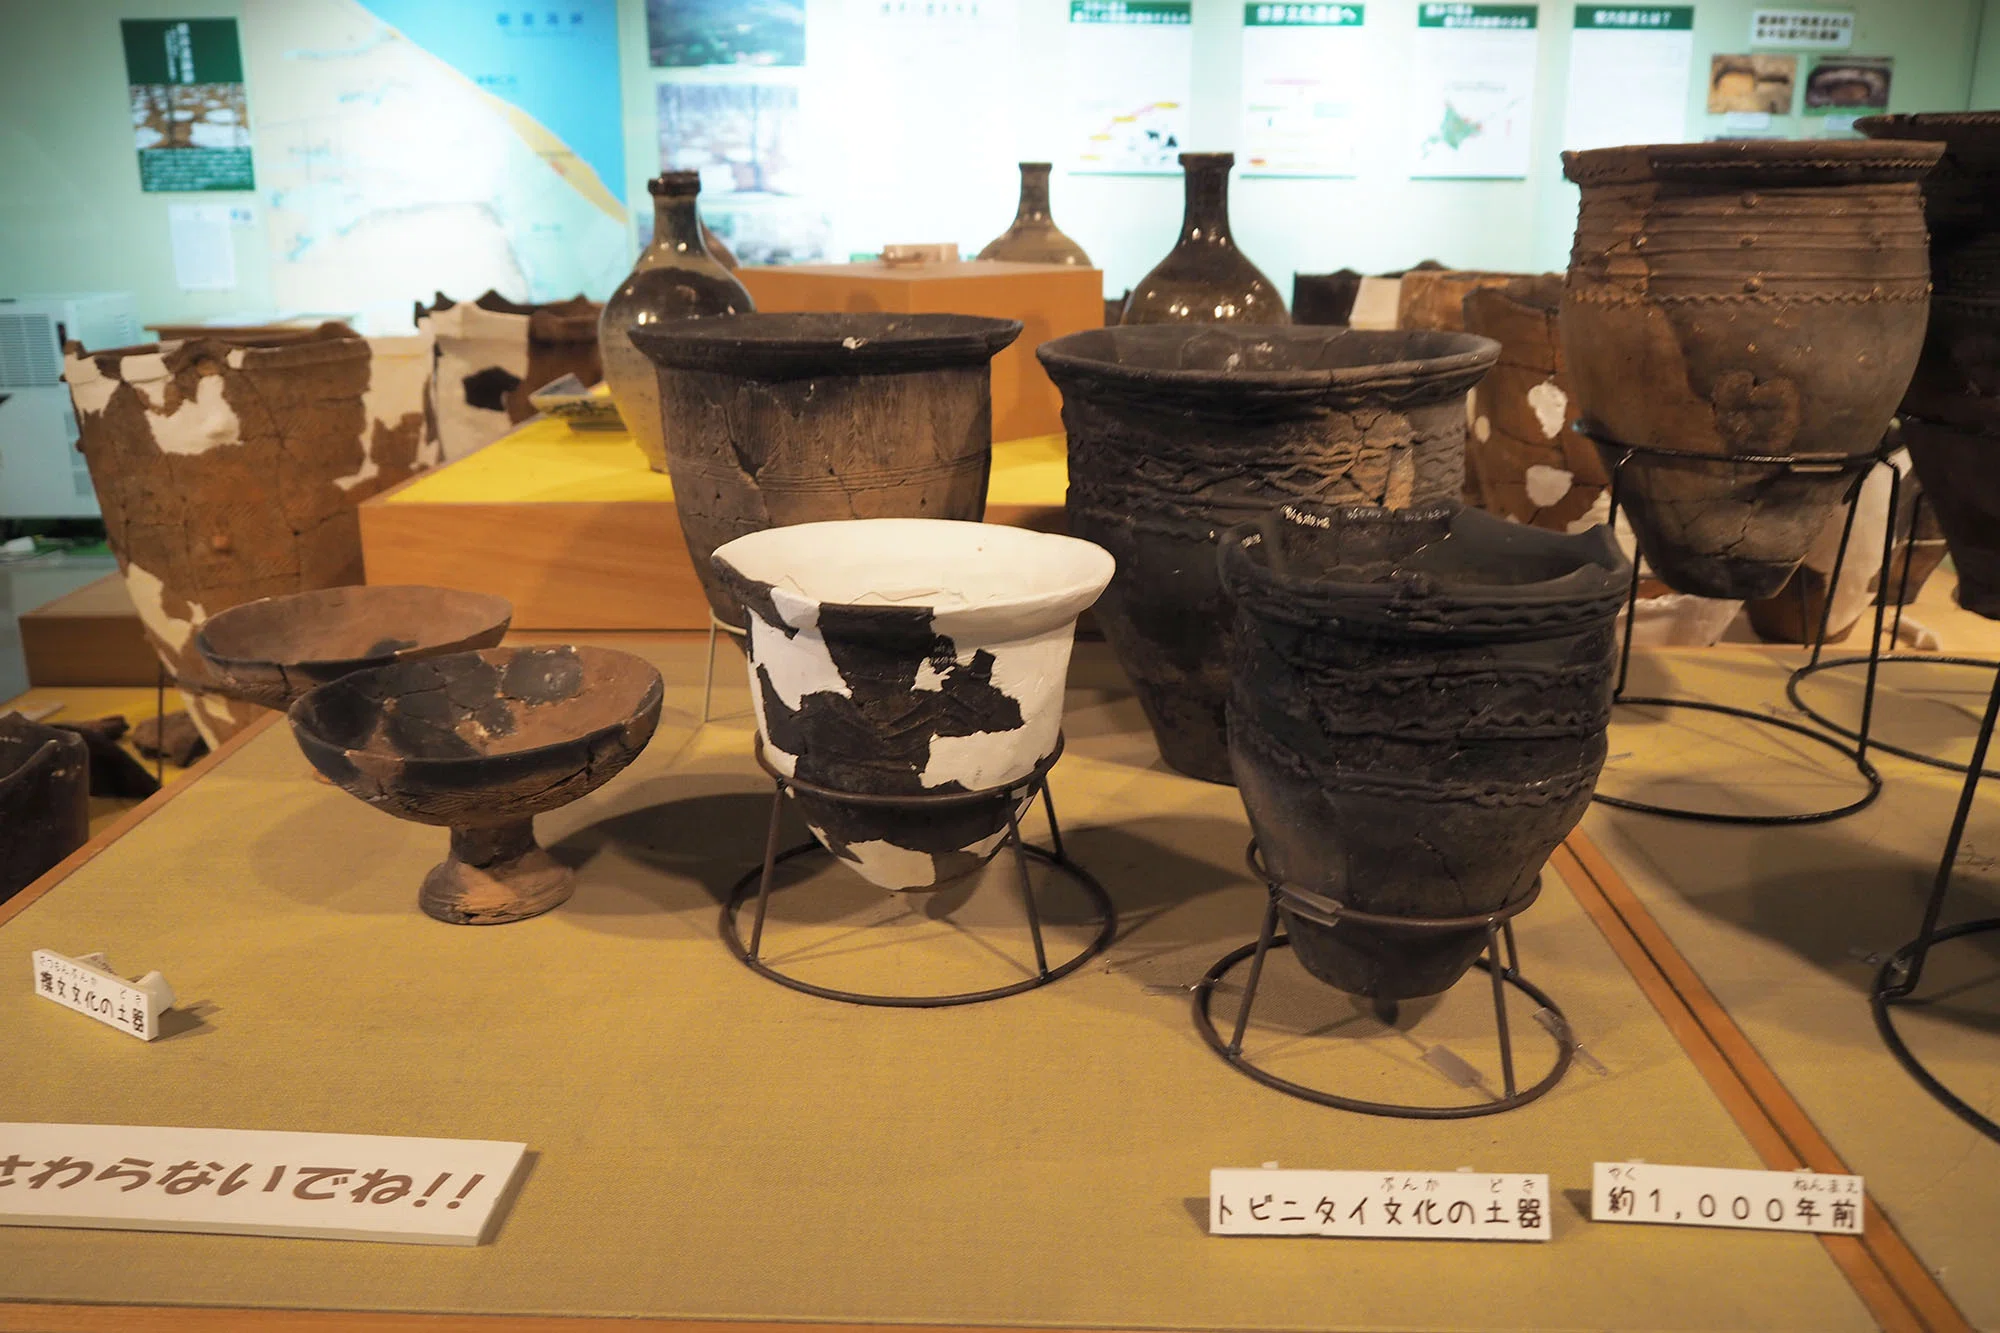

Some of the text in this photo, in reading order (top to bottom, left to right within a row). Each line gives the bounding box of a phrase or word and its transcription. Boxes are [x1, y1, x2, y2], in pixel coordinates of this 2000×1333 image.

[1219, 1194, 1542, 1229] トビニタイ文化の土器
